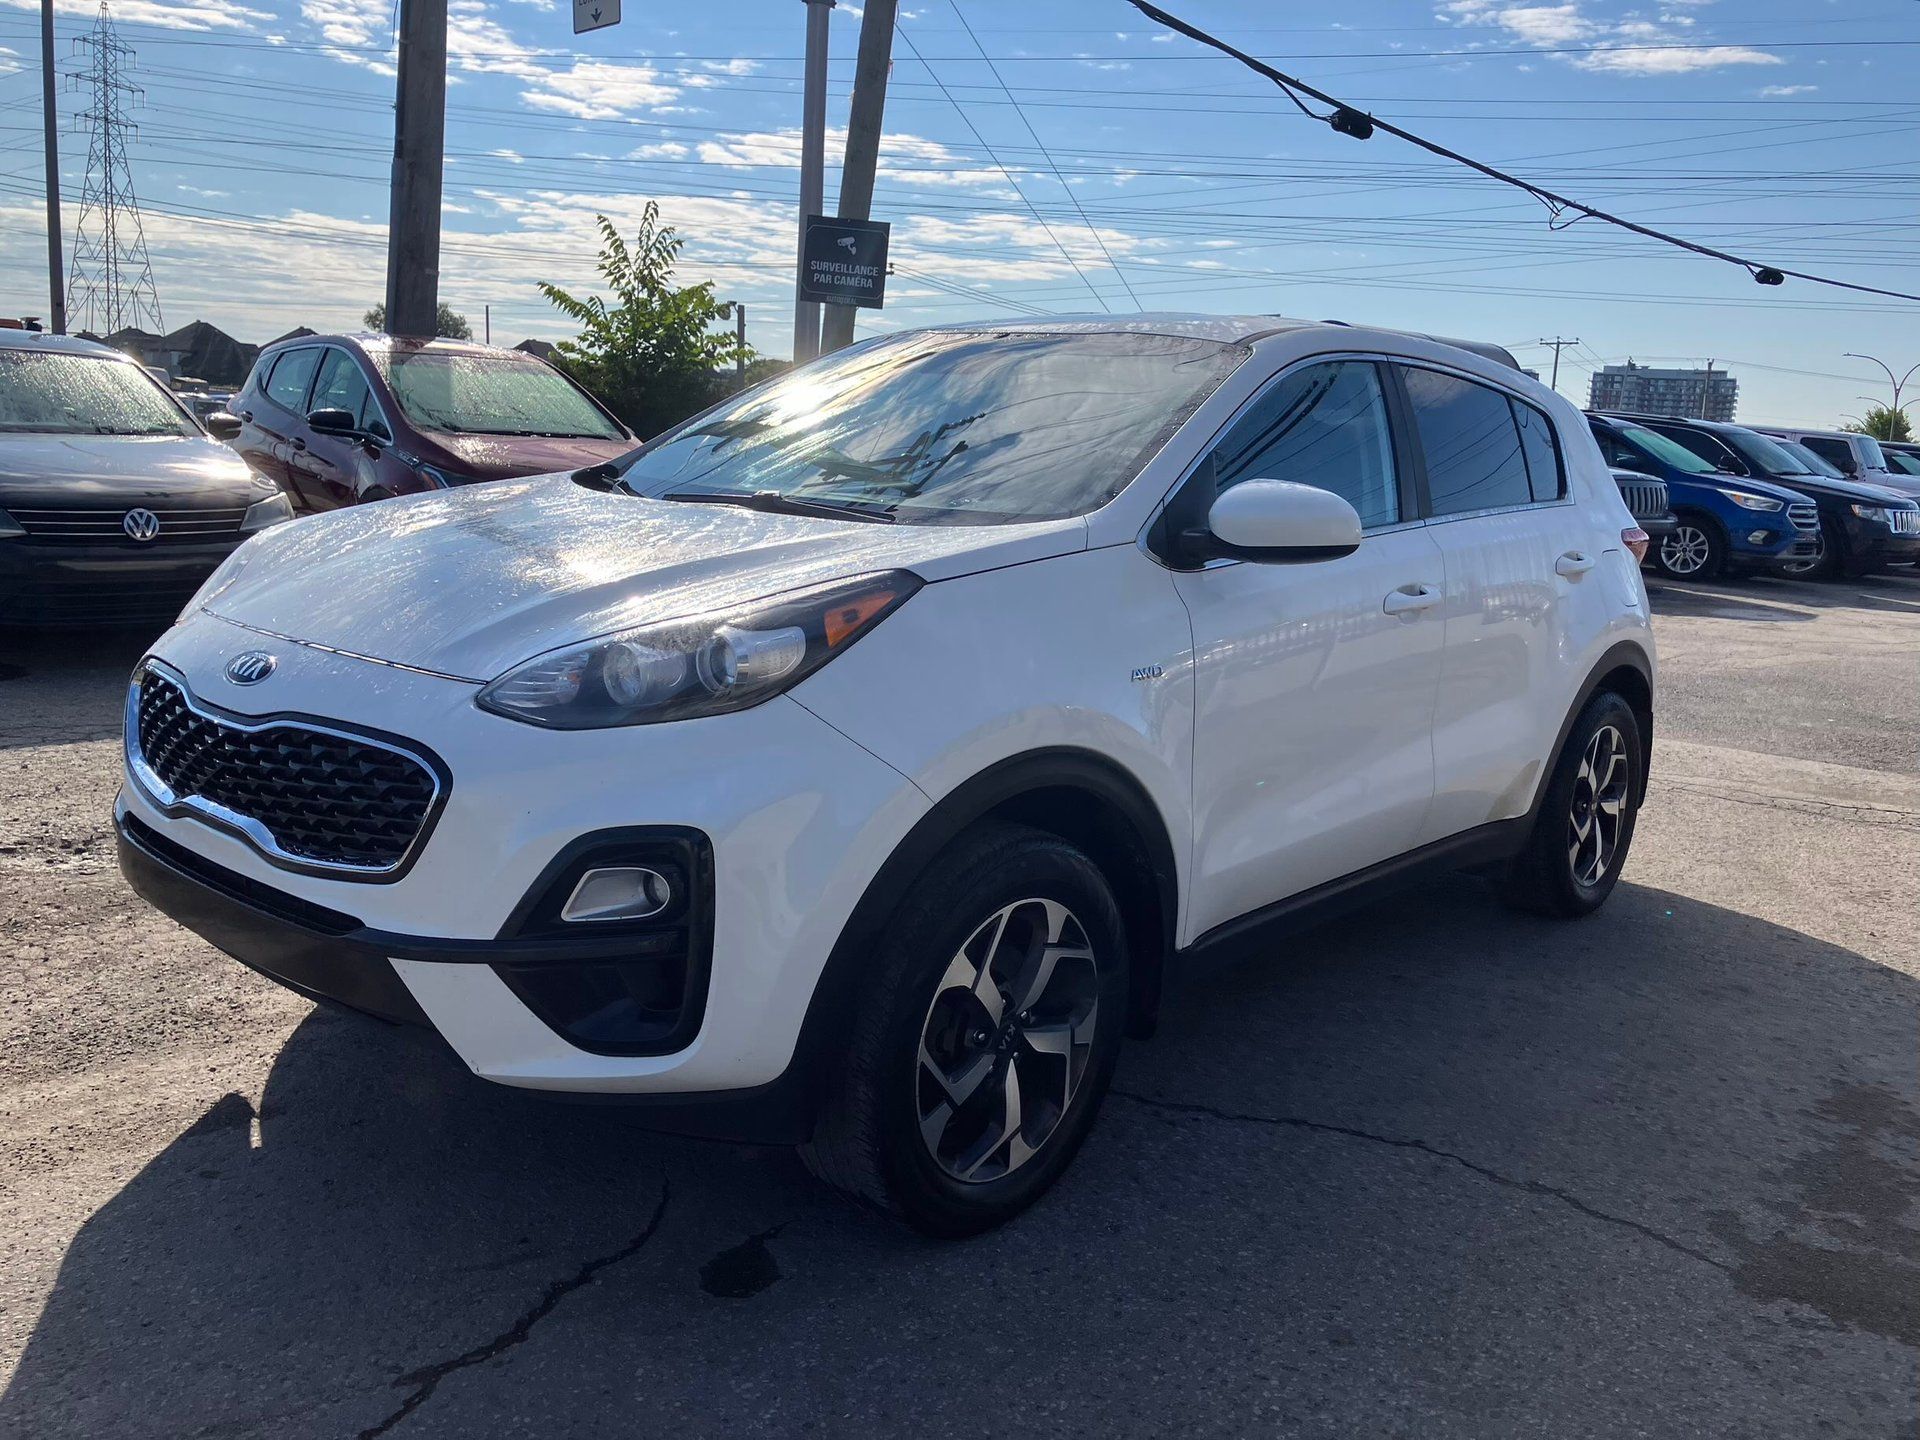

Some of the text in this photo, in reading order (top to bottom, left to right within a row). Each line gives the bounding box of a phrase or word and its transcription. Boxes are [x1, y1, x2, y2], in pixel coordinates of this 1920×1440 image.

[811, 260, 879, 277] SURVEILLANCE
[813, 272, 873, 288] PAR CAMÉRA
[229, 655, 266, 680] KIA
[1130, 665, 1163, 682] AWD
